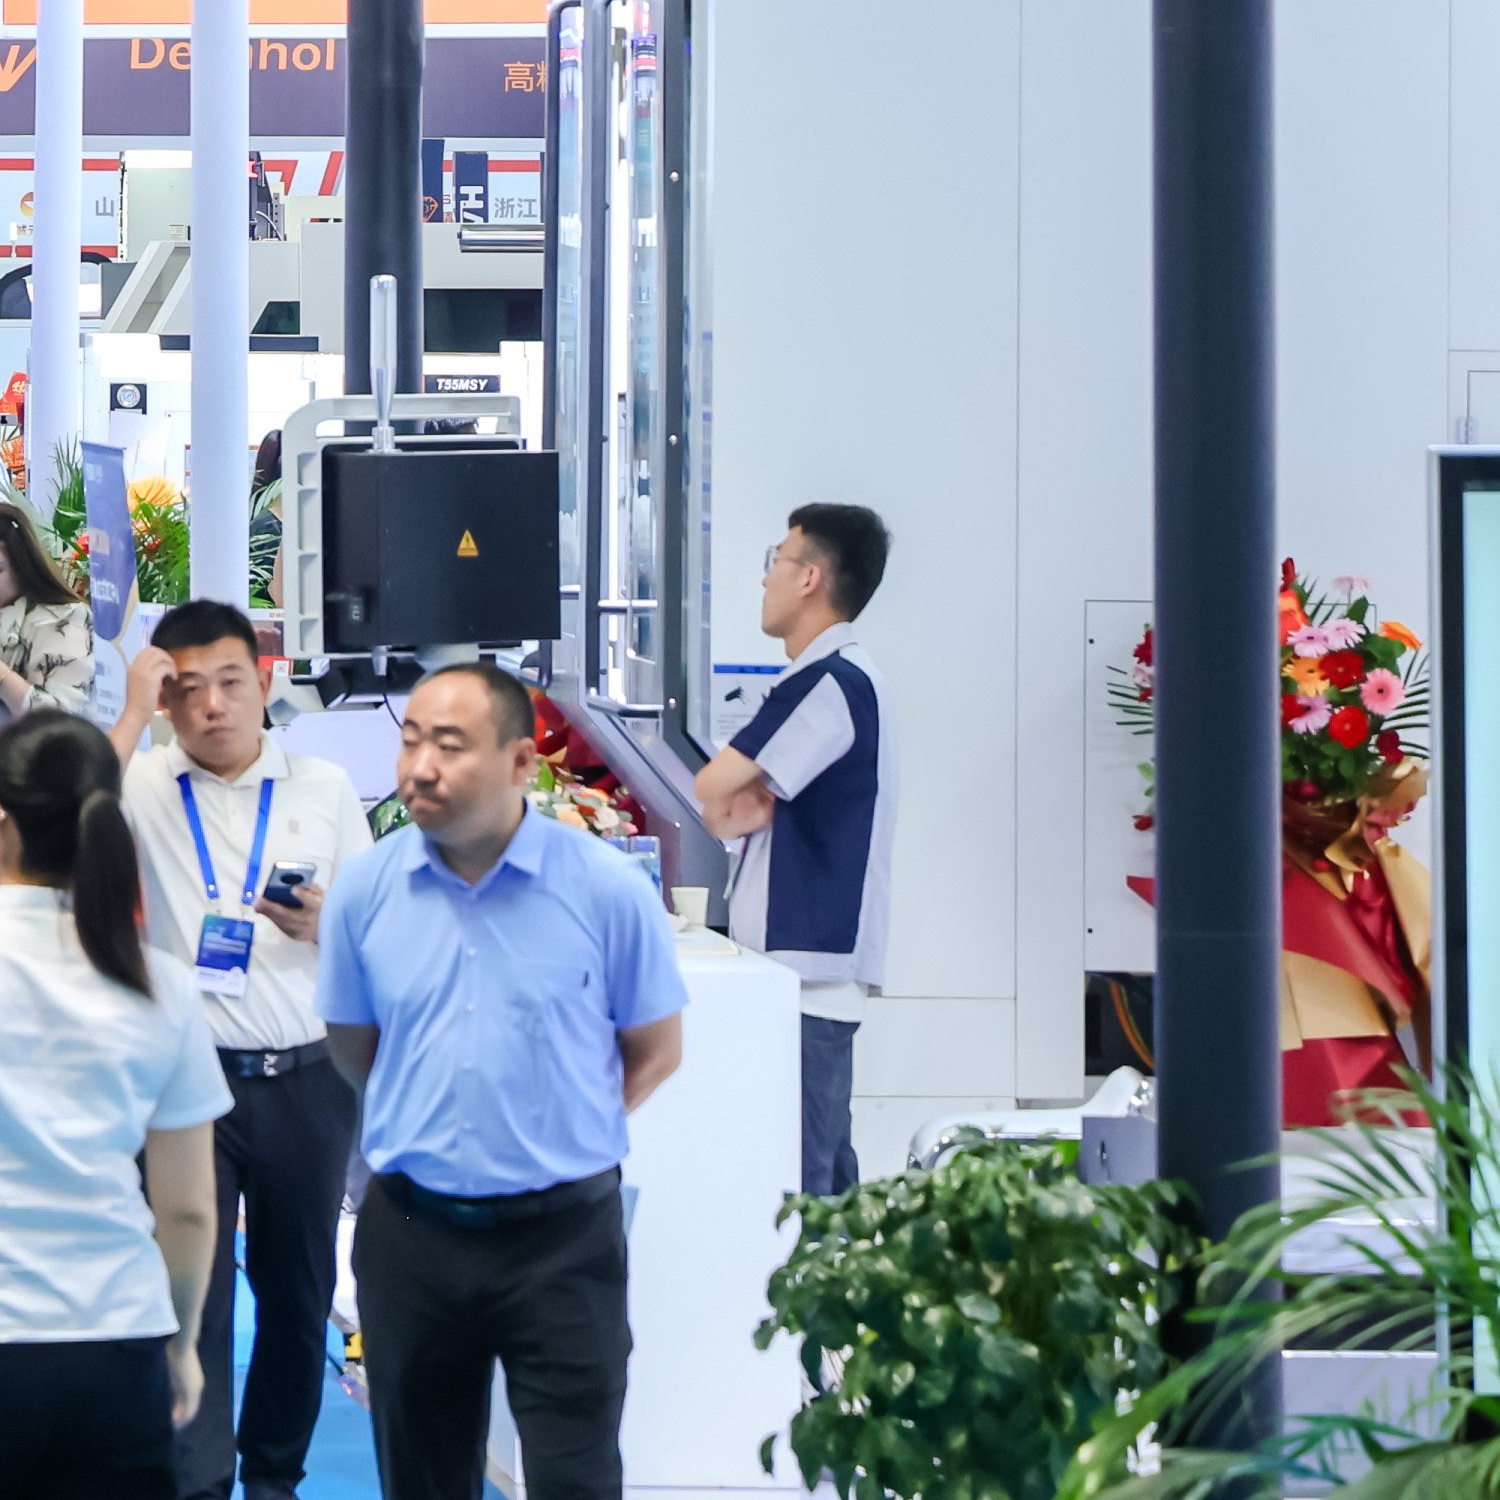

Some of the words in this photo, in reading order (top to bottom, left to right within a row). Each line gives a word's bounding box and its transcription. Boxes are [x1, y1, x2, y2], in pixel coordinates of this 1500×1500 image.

[130, 38, 336, 71] Dehol
[493, 197, 538, 219] 浙江
[436, 377, 489, 392] T55MSY
